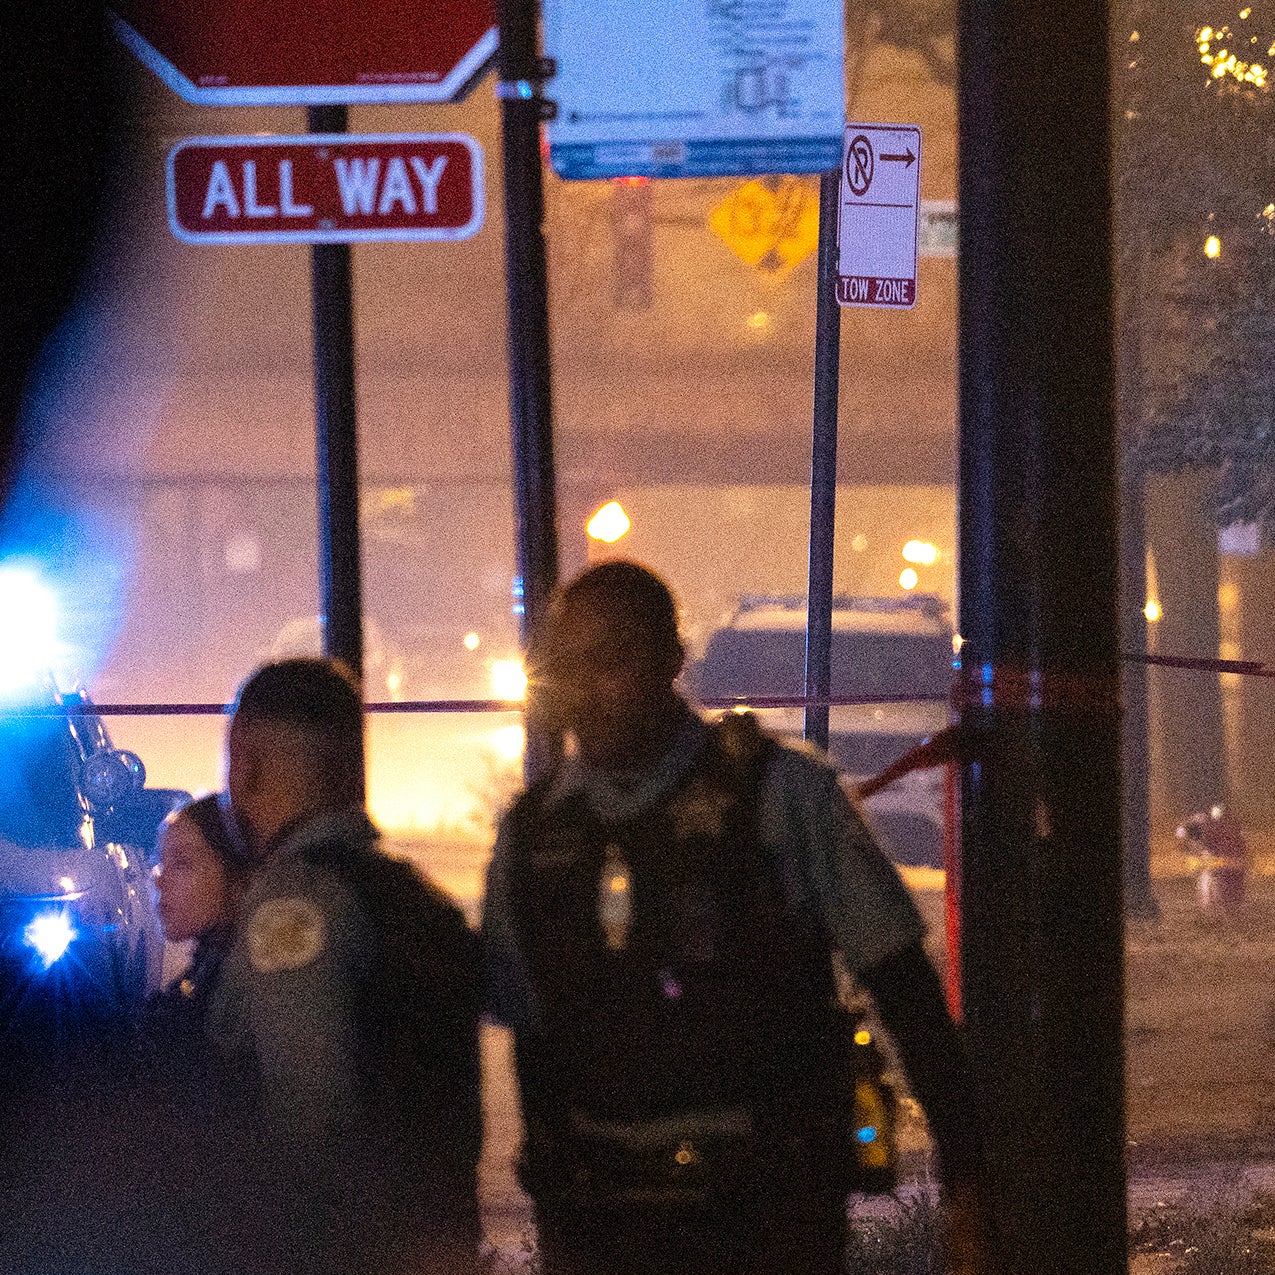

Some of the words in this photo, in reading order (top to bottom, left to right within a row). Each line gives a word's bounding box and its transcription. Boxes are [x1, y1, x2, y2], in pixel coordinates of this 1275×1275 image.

[202, 159, 314, 218] ALL
[333, 155, 449, 215] WAY
[842, 278, 869, 300] TOW
[875, 280, 910, 302] ZONE
